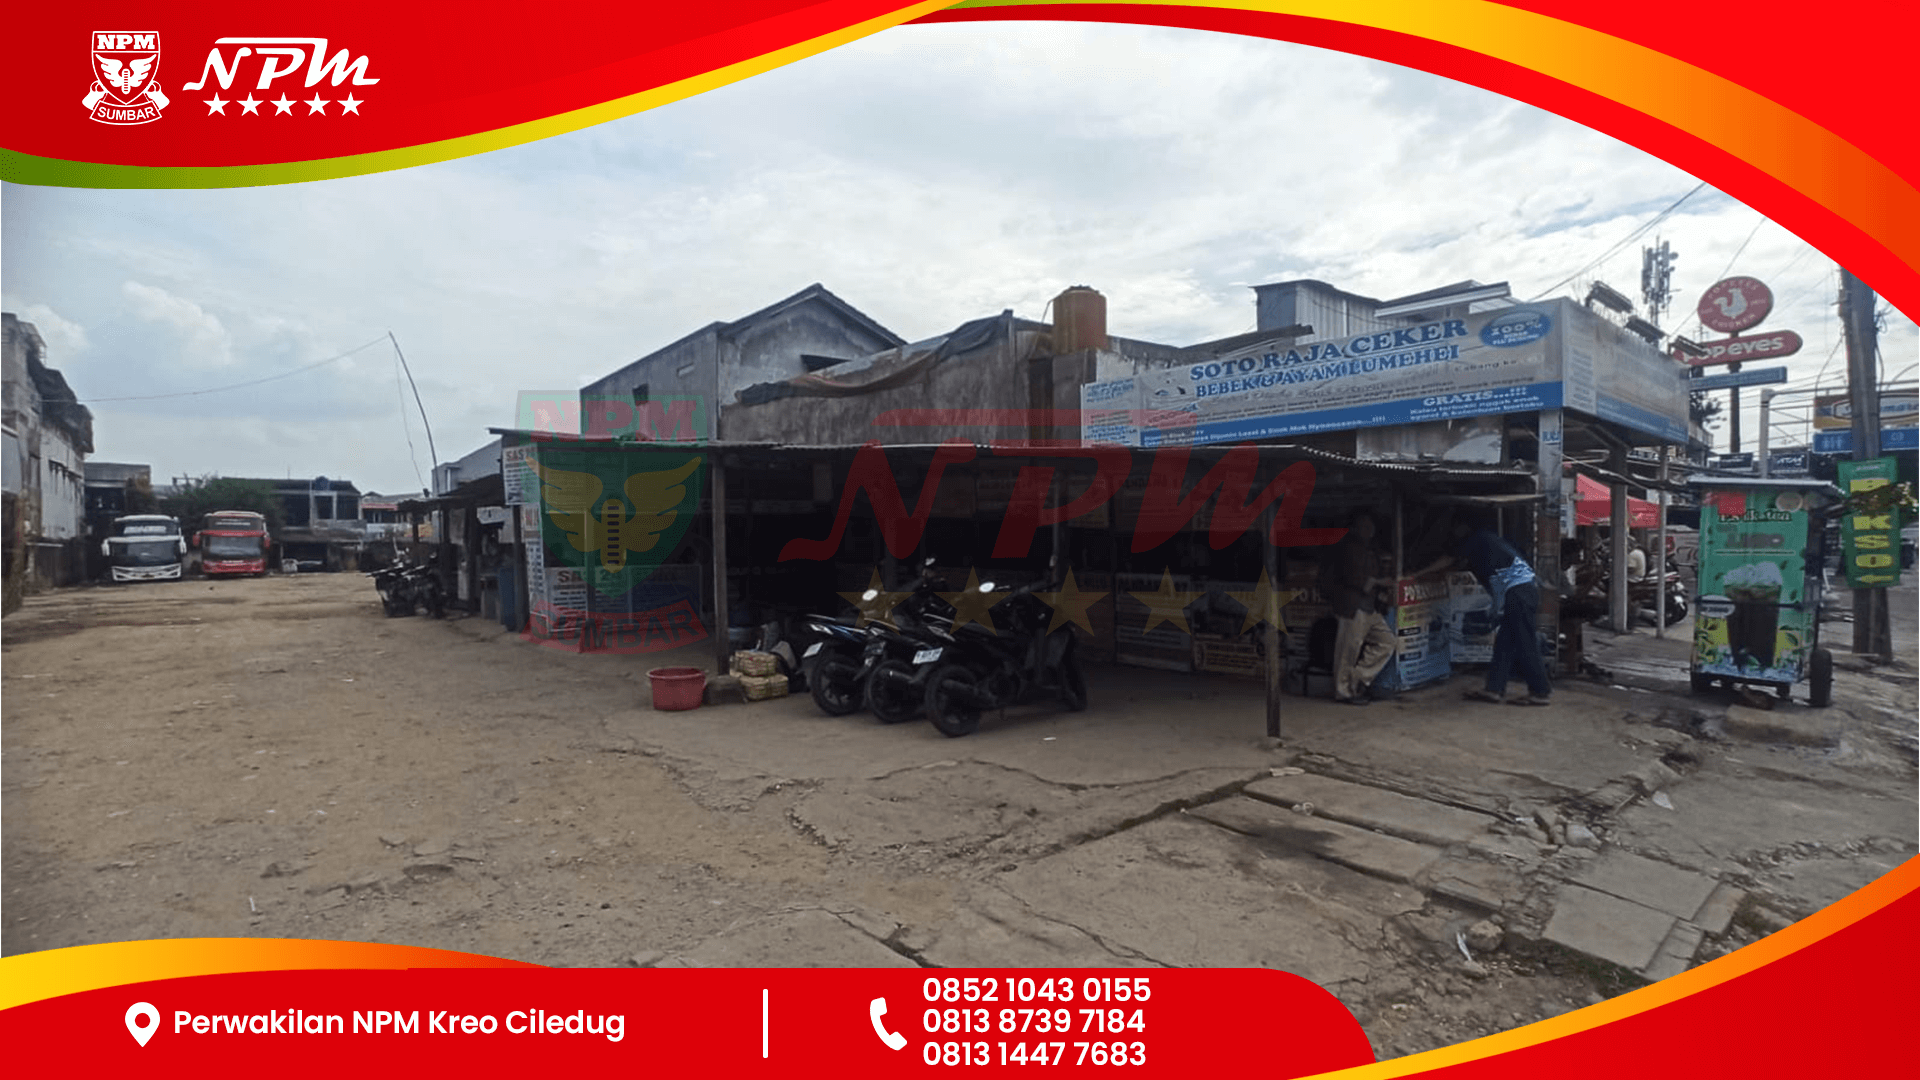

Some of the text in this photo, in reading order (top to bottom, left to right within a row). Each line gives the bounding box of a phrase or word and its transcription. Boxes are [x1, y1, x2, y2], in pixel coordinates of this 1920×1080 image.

[1190, 357, 1256, 381] SOTO
[1263, 343, 1342, 369] RAJA
[1351, 319, 1469, 353] CEKER
[1196, 379, 1257, 398] BEBEK
[1281, 364, 1342, 385] AYAM
